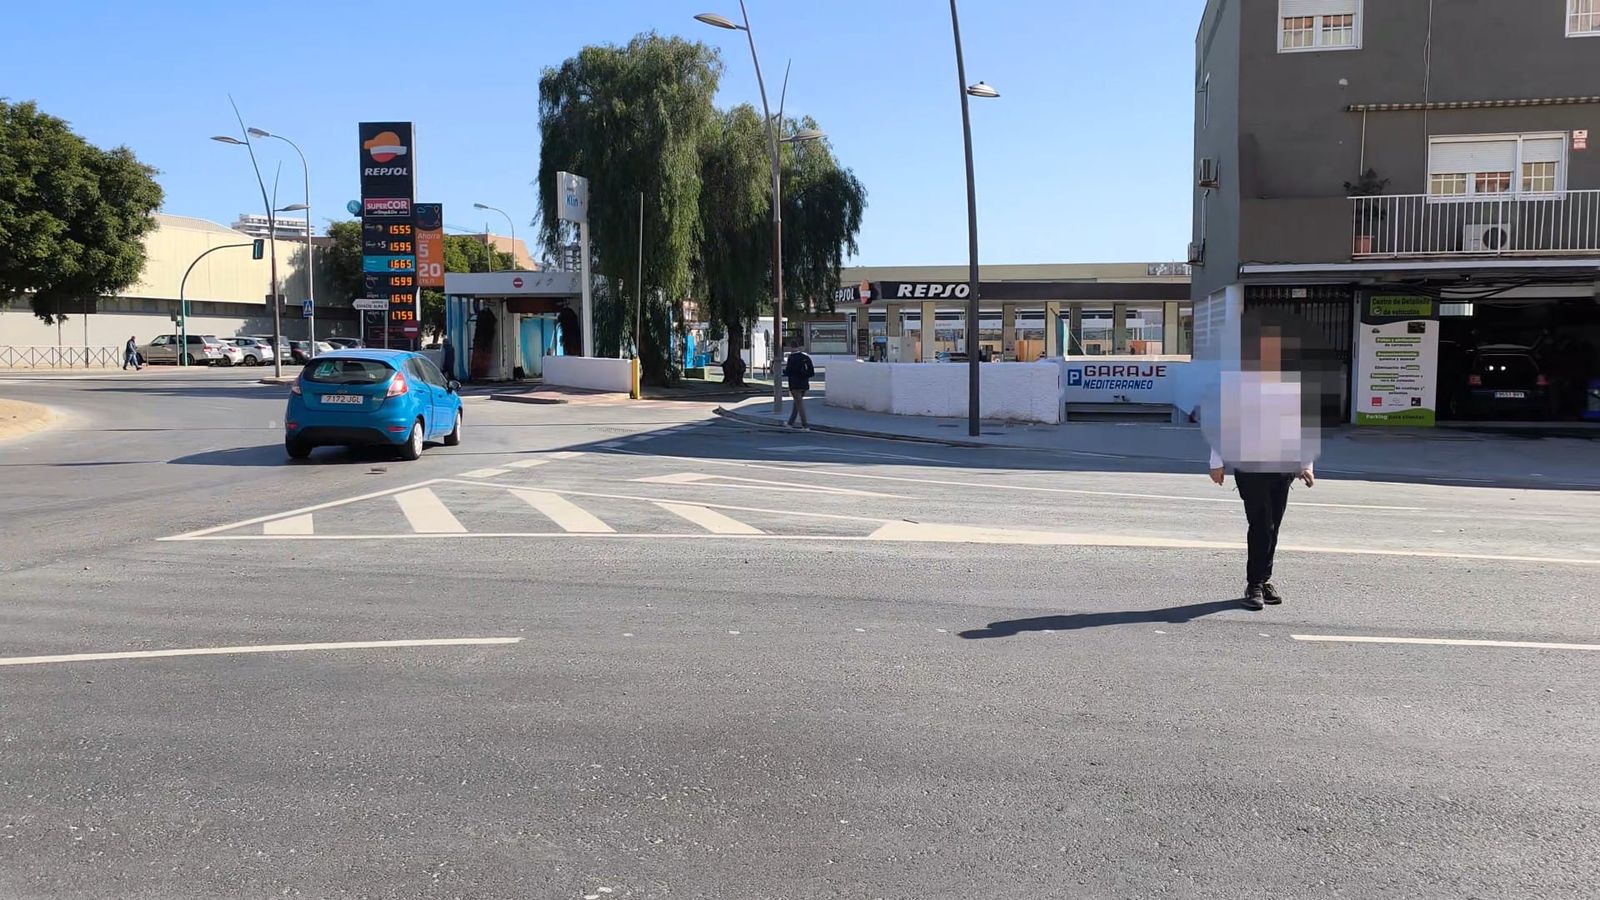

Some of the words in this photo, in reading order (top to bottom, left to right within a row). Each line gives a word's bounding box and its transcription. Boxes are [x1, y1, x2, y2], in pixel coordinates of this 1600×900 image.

[364, 167, 408, 176] REPSOL
[418, 232, 440, 240] Ahorra
[418, 263, 441, 277] 20
[897, 284, 980, 298] REPSO
[1084, 365, 1167, 377] GARAJE
[1083, 380, 1154, 390] MEDITERRANEO
[325, 395, 346, 403] 7172
